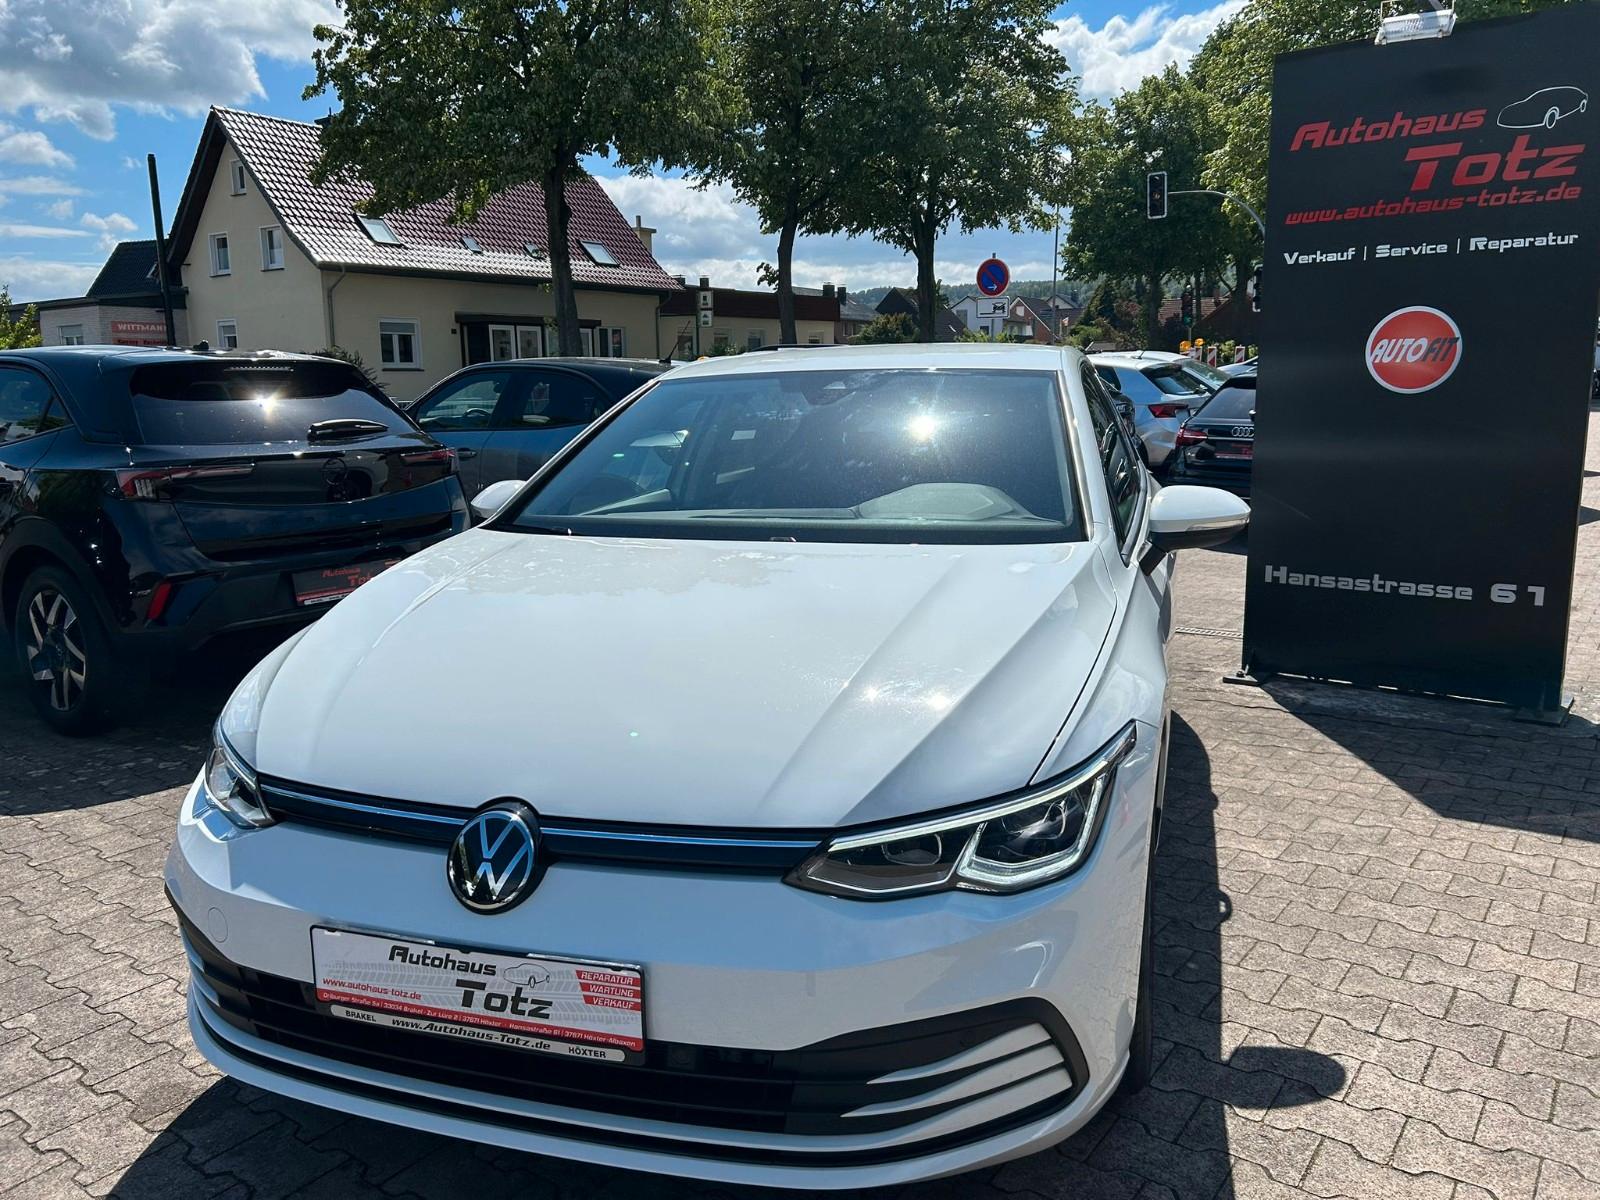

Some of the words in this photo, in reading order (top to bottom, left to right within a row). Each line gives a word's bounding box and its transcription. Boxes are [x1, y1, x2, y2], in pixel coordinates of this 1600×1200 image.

[1290, 107, 1487, 151] Autohaus
[1404, 134, 1586, 192] Totz
[1285, 181, 1582, 225] www.autohaus-totz.de
[1283, 247, 1356, 265] Verkauf
[1375, 241, 1448, 259] Service
[1469, 231, 1578, 253] Reparatur
[1370, 336, 1460, 363] AUTOFIT
[1264, 564, 1473, 601] Hansastrasse
[1490, 582, 1546, 607] 61
[388, 945, 497, 977] Autohaus
[322, 978, 422, 1001] www.autohaus-totz.de
[581, 971, 634, 985] REPARATUR
[589, 984, 634, 998] WARTUNG
[403, 1006, 424, 1014] Brakel
[455, 978, 553, 1020] Totz
[592, 997, 635, 1009] VERKAUF
[345, 1009, 377, 1022] BRAKEL
[391, 1018, 551, 1050] www.Autohaus-Totz.de
[568, 1045, 607, 1059] HÖXTER
